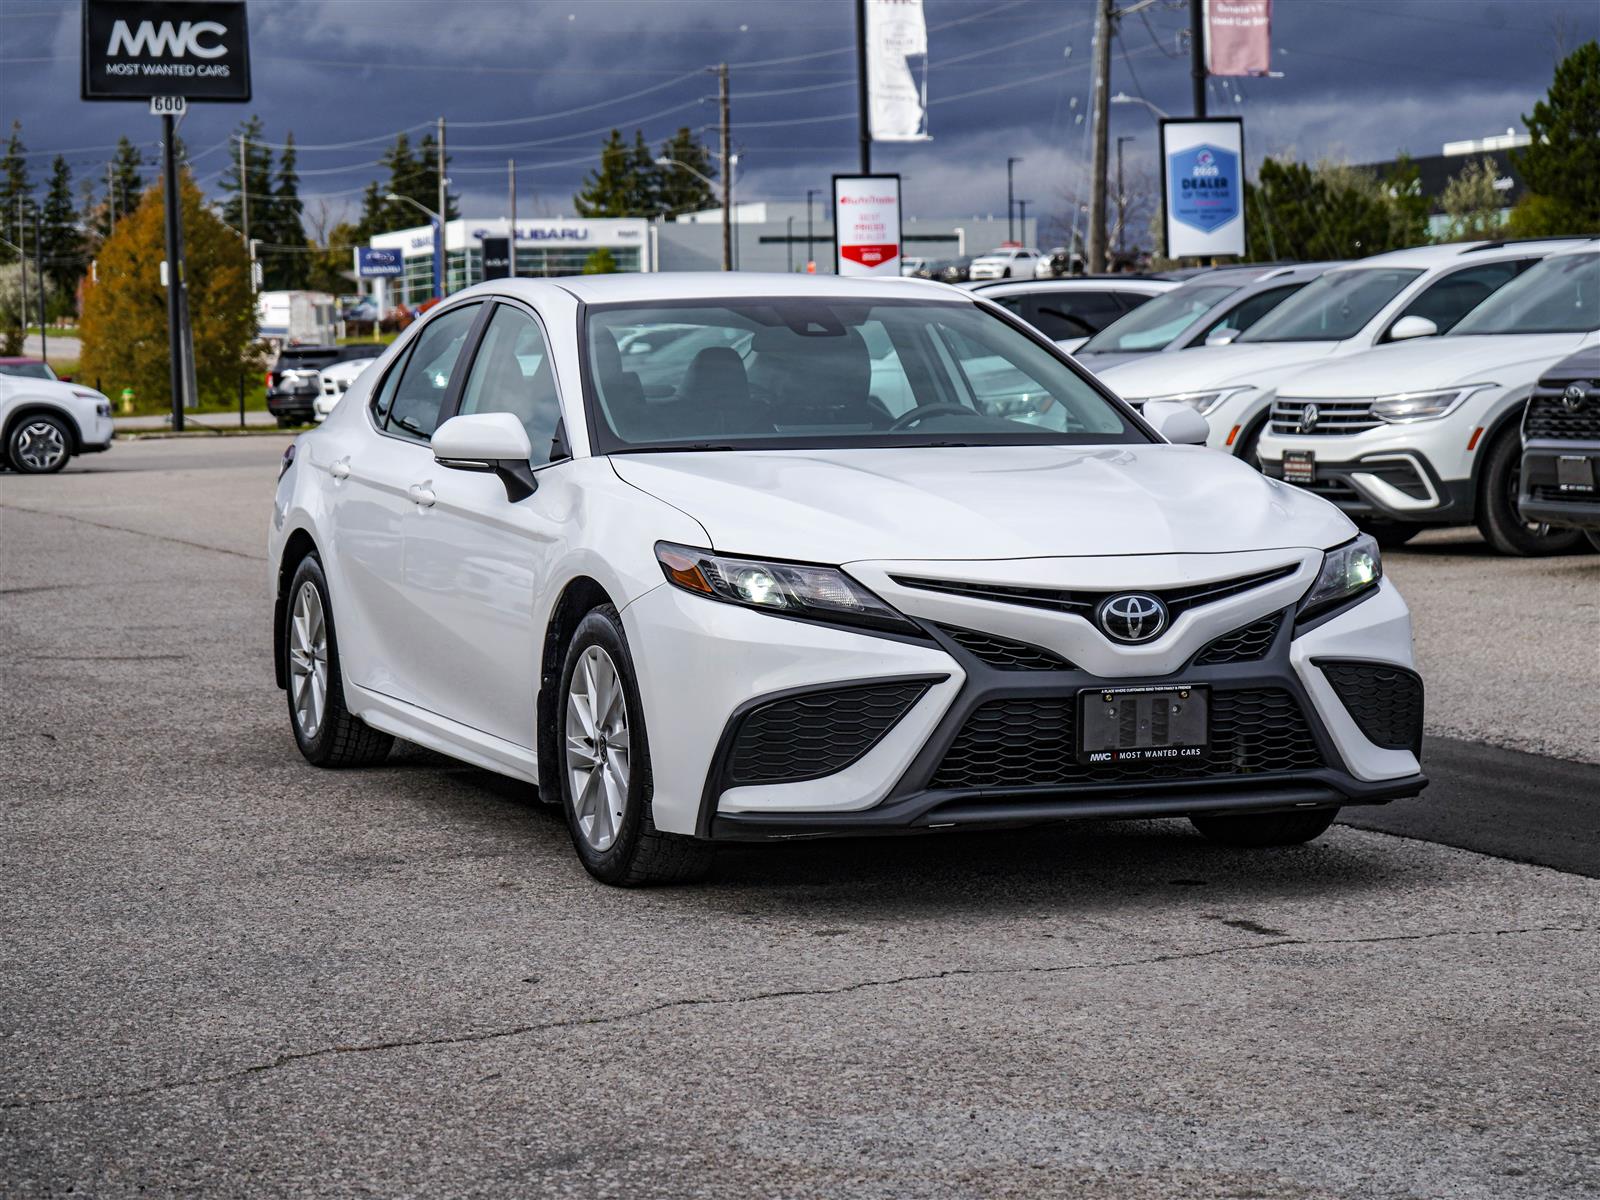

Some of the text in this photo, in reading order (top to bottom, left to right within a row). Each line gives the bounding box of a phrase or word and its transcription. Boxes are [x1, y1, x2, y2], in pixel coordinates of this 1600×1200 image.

[106, 20, 228, 58] MWC
[106, 64, 230, 77] MOST WANTED CARS
[154, 97, 183, 110] 600
[1181, 178, 1229, 189] DEALER
[1090, 748, 1200, 761] MWC MOST WANTED CARS
